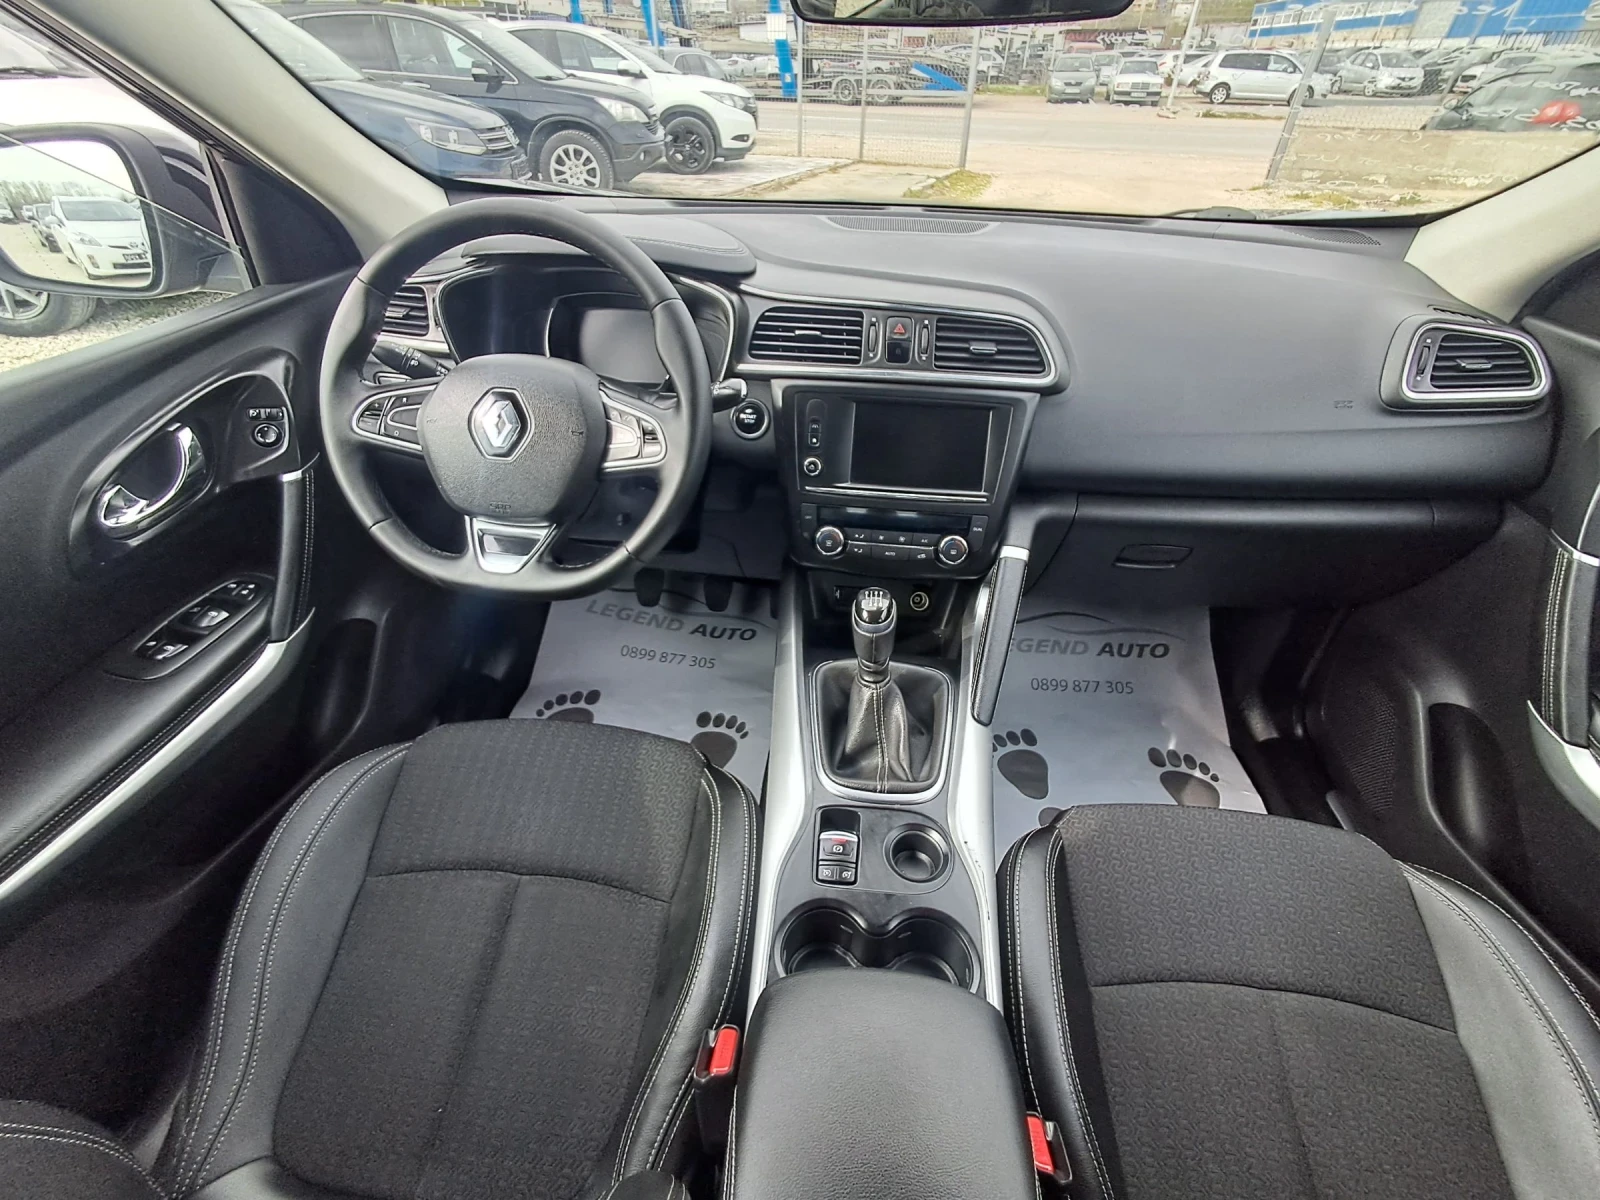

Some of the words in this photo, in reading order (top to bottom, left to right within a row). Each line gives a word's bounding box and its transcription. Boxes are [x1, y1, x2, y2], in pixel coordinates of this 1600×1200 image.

[585, 599, 684, 632] LEGEND
[689, 623, 757, 641] AUTO
[620, 644, 656, 661] 0899
[659, 652, 686, 665] 877
[689, 656, 717, 669] 305
[1010, 637, 1089, 655] GEND
[1096, 642, 1170, 658] AUTO
[1030, 677, 1068, 692] 0899
[1072, 680, 1100, 693] 877
[1105, 680, 1134, 694] 305
